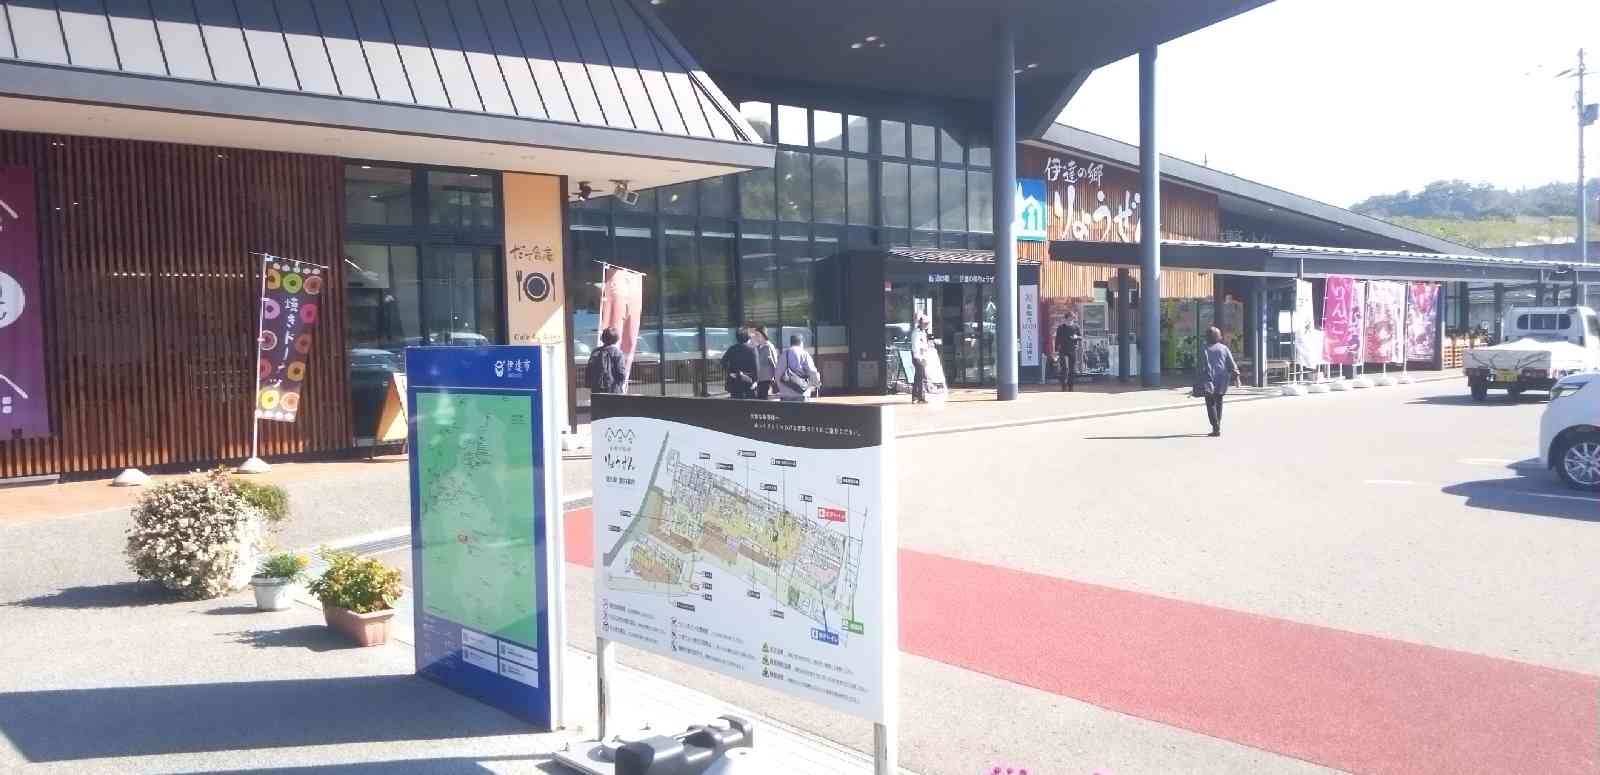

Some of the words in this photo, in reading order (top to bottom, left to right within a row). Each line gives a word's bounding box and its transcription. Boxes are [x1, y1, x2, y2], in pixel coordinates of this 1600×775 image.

[1045, 156, 1104, 189] 伊達の郷
[1053, 184, 1141, 243] りょうぜ
[1331, 281, 1347, 335] りんご
